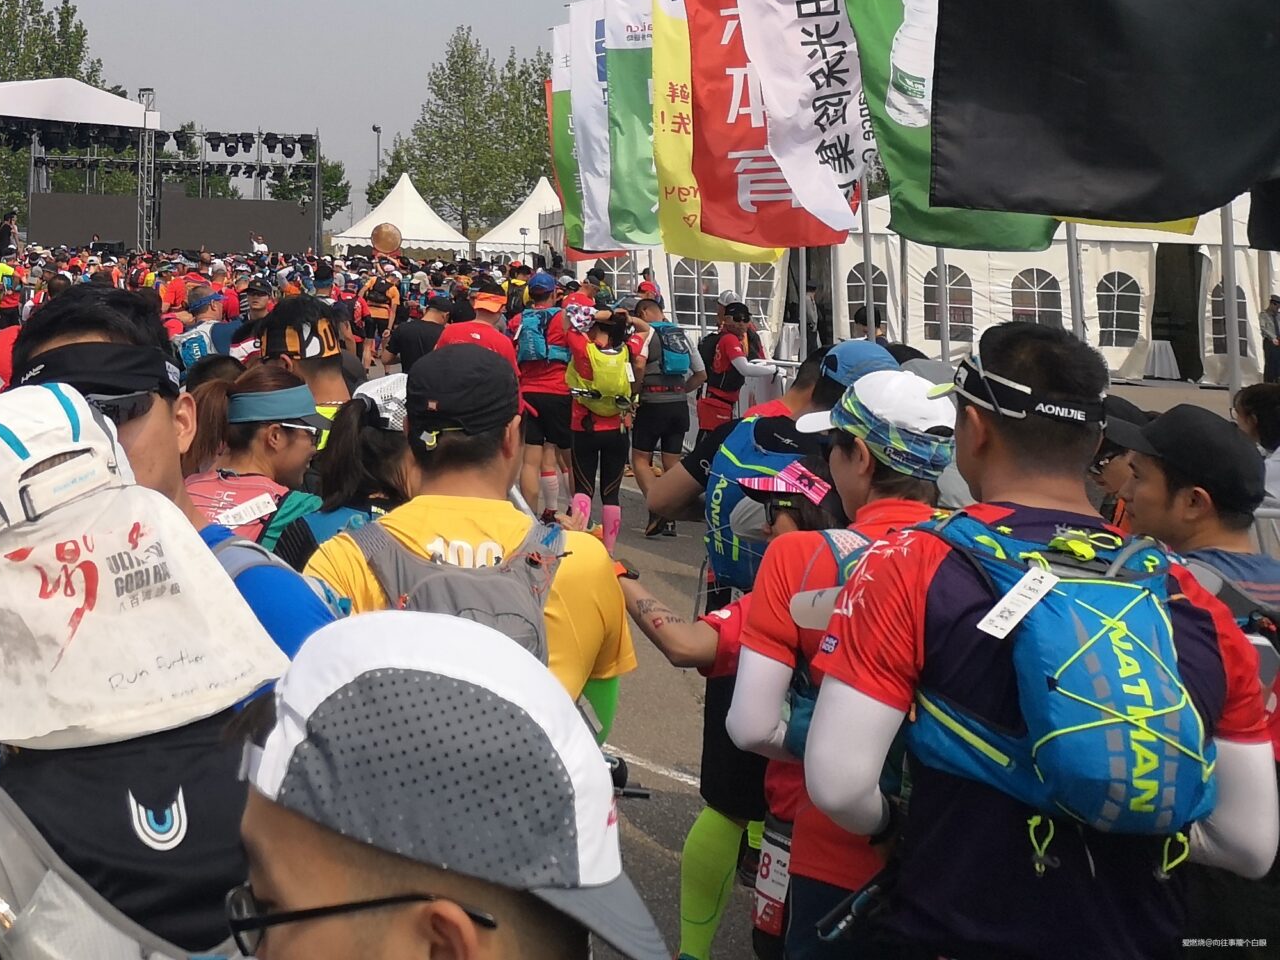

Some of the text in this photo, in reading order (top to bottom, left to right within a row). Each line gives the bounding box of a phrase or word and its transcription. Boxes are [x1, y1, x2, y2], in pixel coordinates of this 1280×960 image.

[1034, 402, 1086, 422] AONIJIE
[114, 567, 151, 598] GOBI
[108, 669, 149, 691] Run
